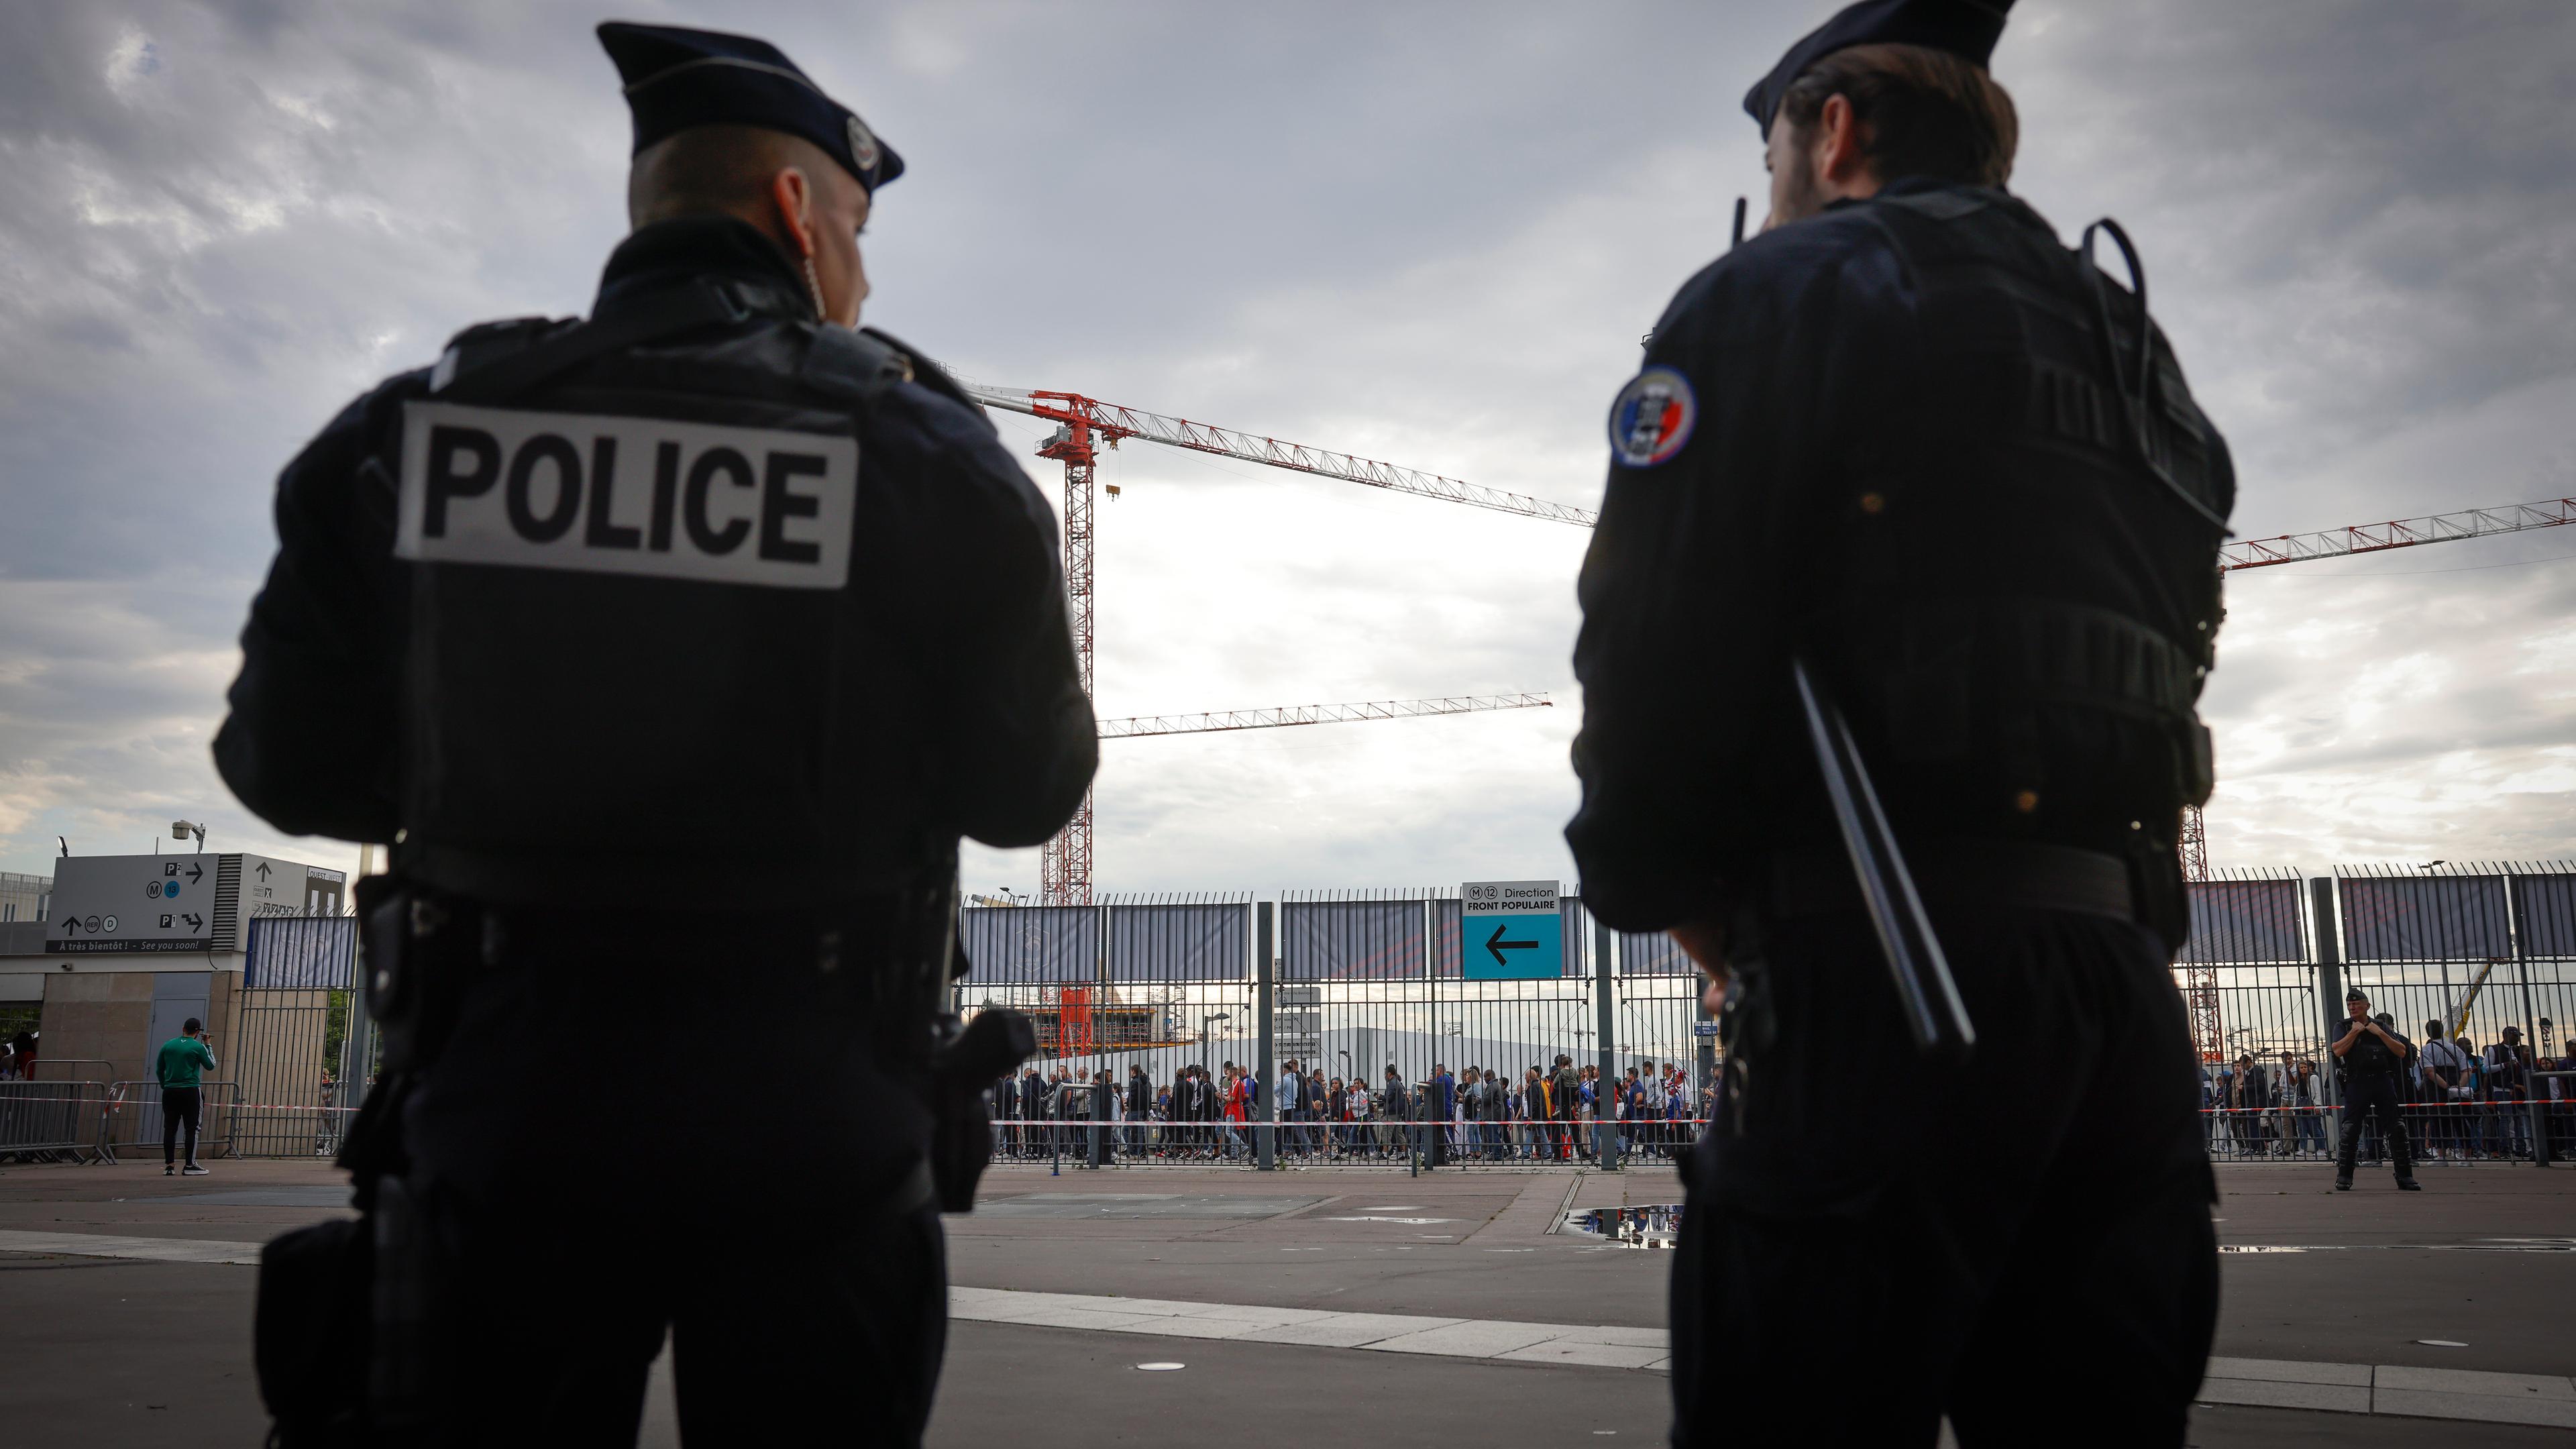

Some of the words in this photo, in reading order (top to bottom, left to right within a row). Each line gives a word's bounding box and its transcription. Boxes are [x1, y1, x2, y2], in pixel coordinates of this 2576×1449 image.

[423, 424, 828, 564] POLICE
[266, 889, 271, 898] X
[1486, 889, 1495, 897] 12
[1505, 888, 1554, 898] Direction
[1468, 902, 1499, 910] FRONT
[1501, 901, 1554, 910] POPULAIRE
[59, 941, 66, 951] À
[68, 941, 86, 951] très
[89, 941, 123, 951] bientôt
[141, 941, 155, 950] See
[157, 942, 173, 951] you
[176, 941, 199, 949] soon!
